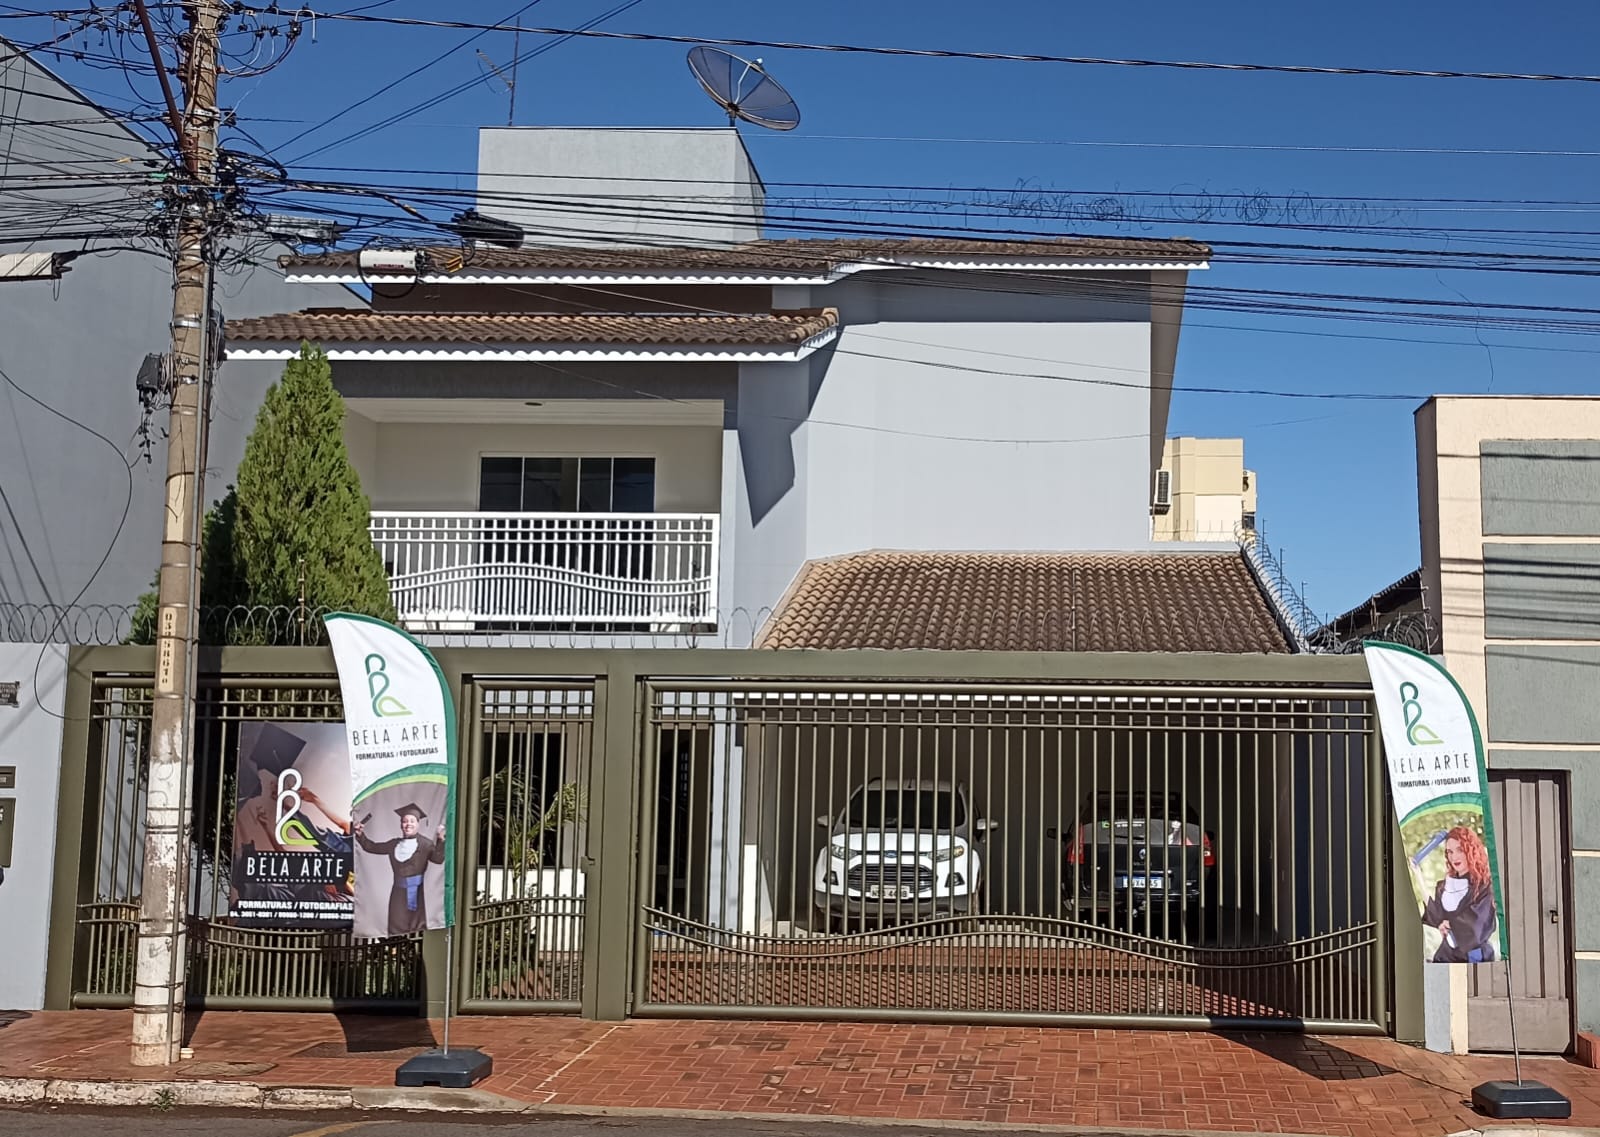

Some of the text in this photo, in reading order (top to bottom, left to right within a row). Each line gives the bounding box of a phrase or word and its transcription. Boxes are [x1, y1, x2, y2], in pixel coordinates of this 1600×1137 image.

[352, 724, 439, 746] BELA ARTE
[355, 751, 394, 761] FORMATURAS
[399, 747, 439, 757] FOTOGRAFIAS
[1434, 753, 1470, 771] ARTE
[246, 856, 344, 877] BELA ARTE
[238, 900, 293, 910] FORMATURAS
[299, 901, 354, 911] FOTOGRAFIAS
